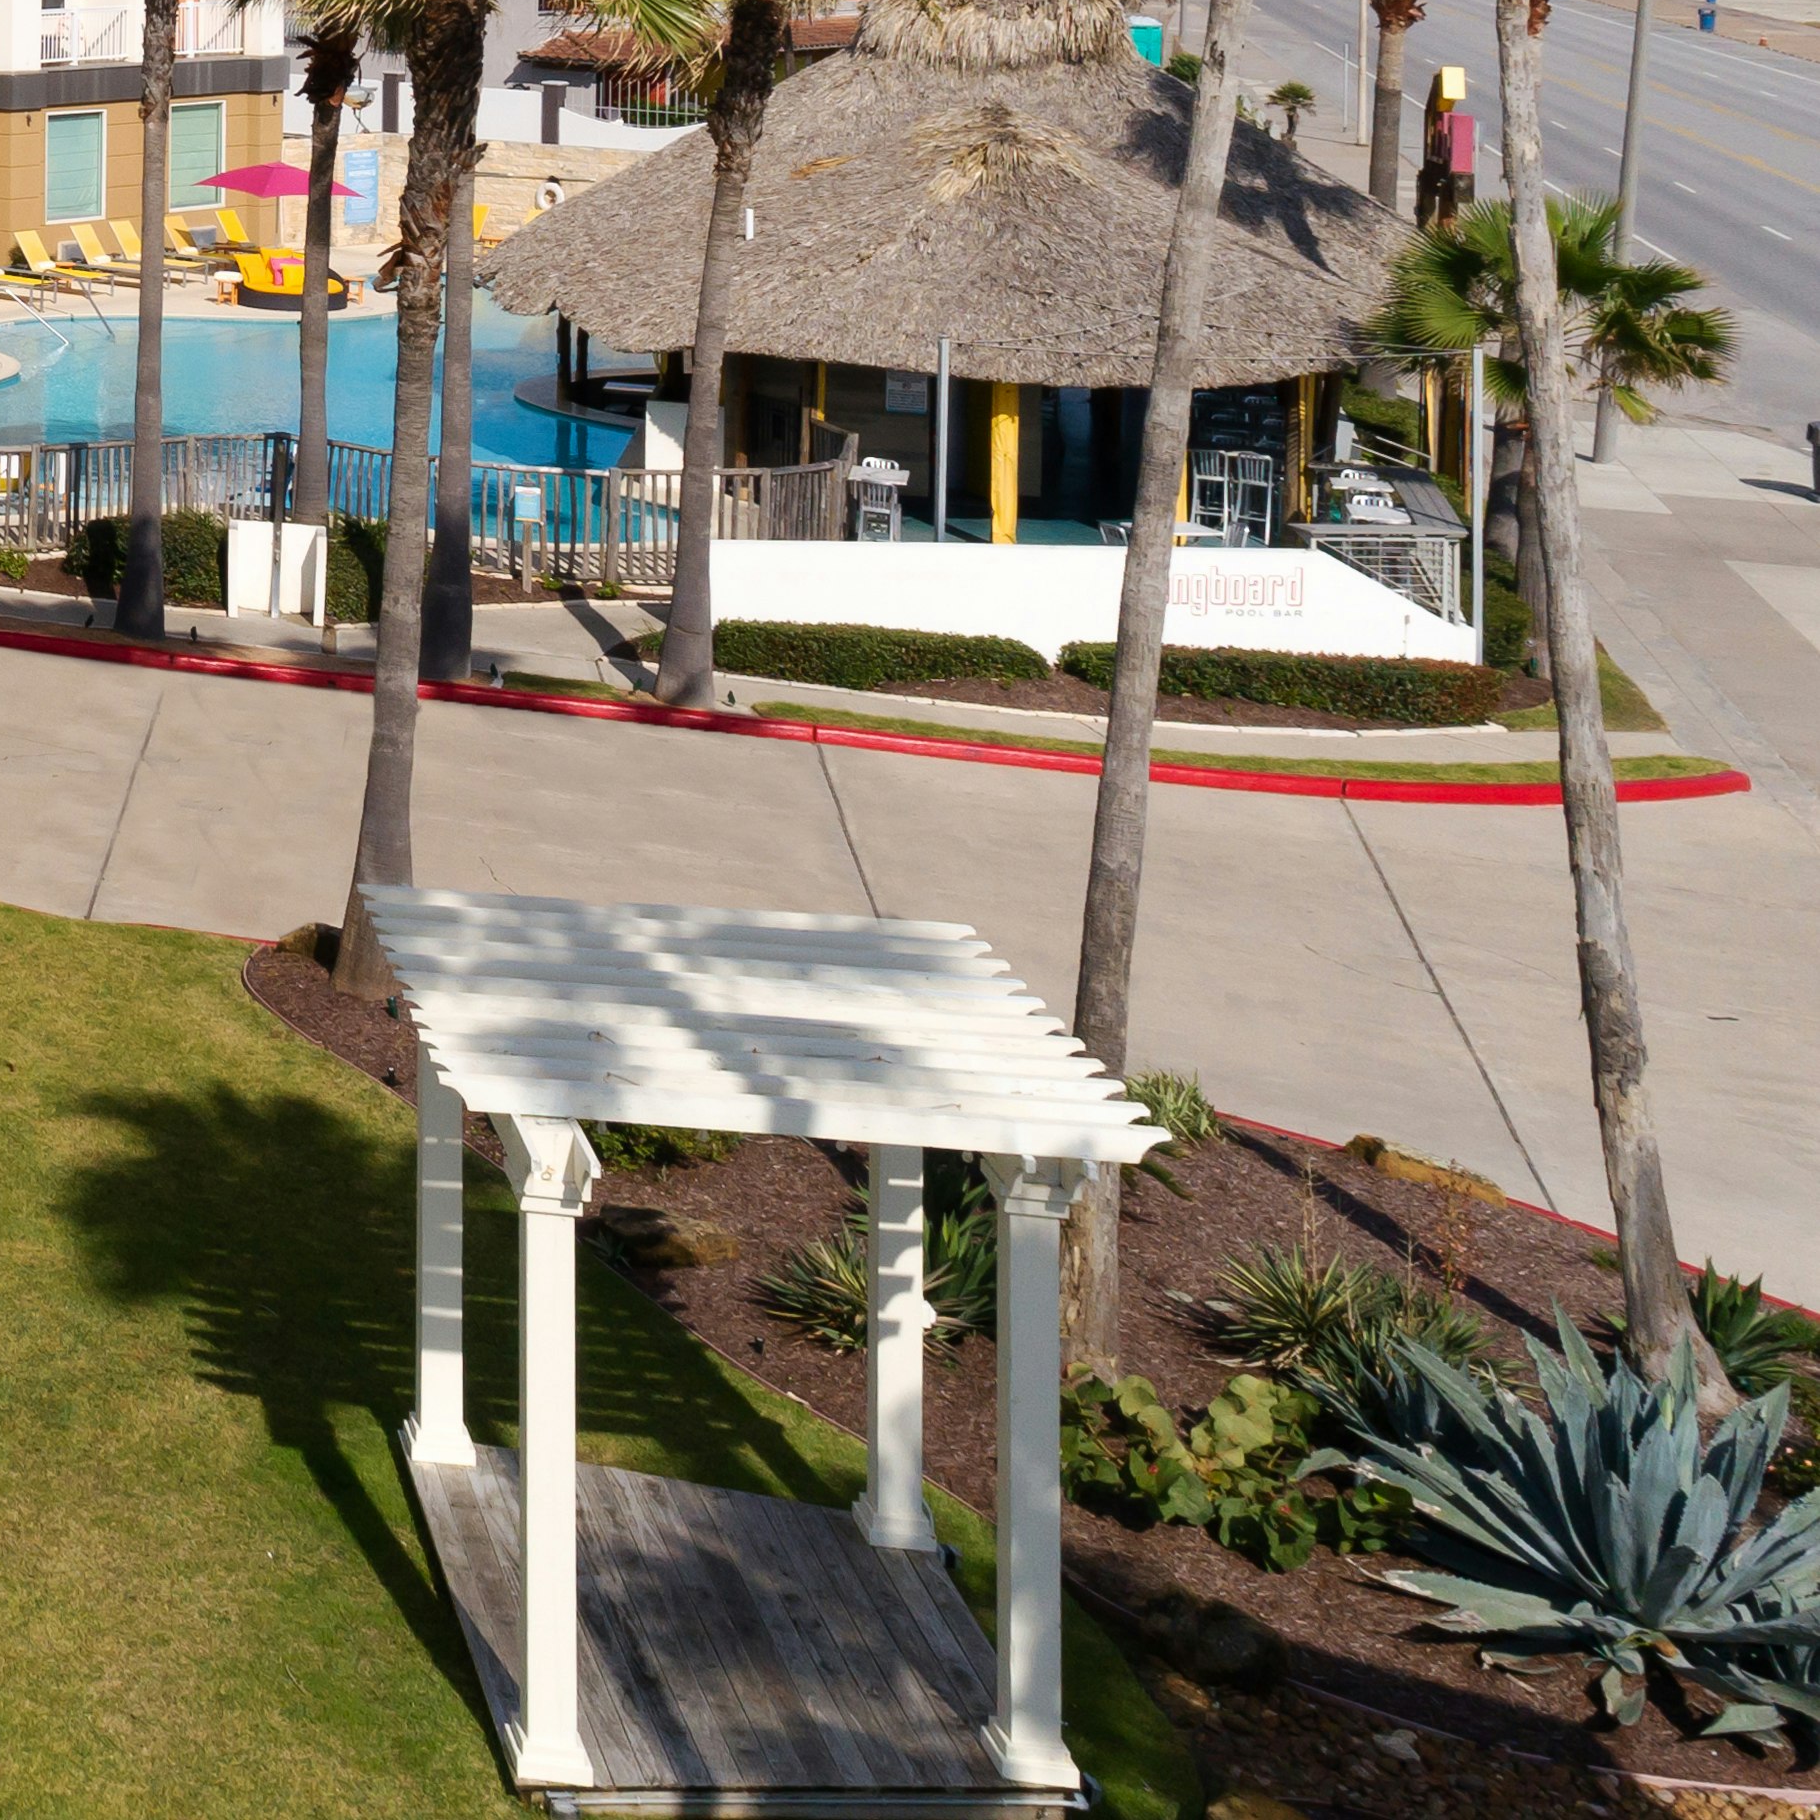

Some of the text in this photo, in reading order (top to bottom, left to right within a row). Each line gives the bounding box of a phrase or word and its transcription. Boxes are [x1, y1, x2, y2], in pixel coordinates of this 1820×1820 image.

[1164, 566, 1304, 617] ngboard
[1225, 609, 1304, 618] POOL BAR
